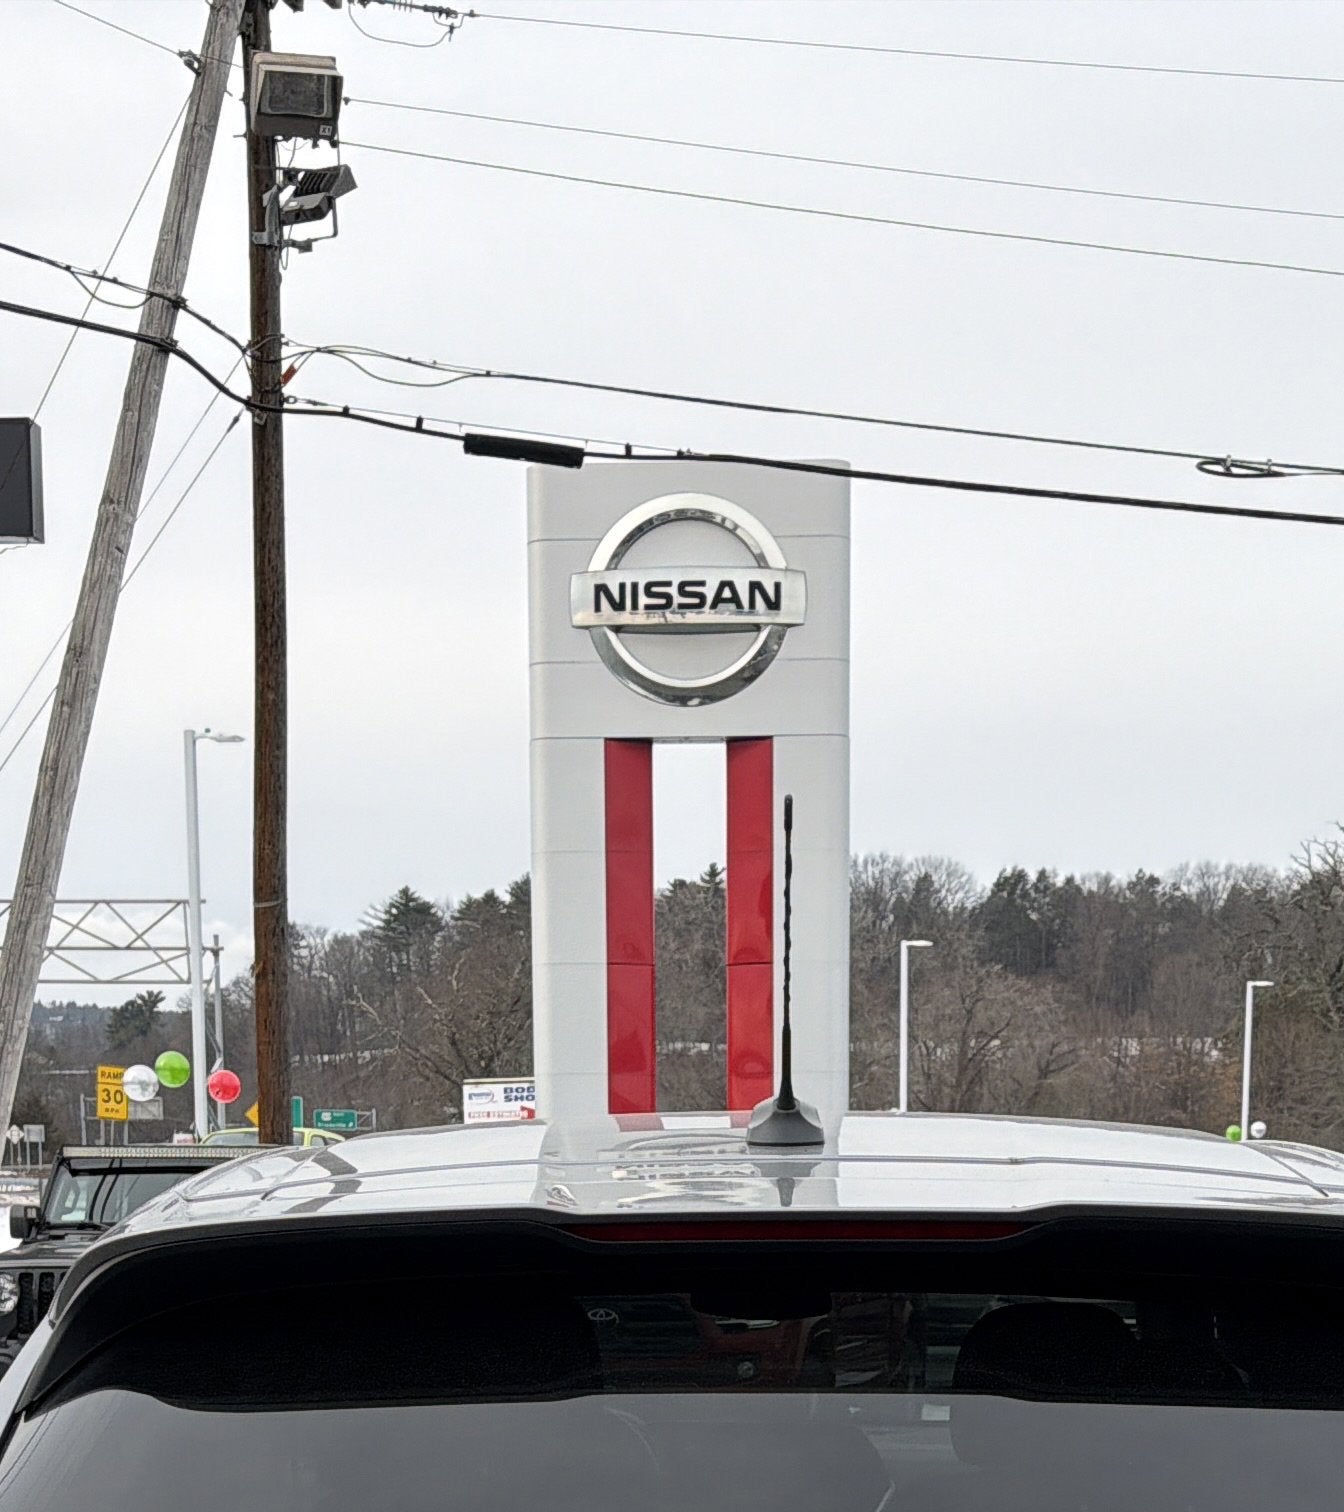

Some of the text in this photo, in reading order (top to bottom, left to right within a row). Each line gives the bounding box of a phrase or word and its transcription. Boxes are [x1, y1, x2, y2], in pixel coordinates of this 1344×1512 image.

[594, 580, 782, 613] NISSAN
[102, 1088, 124, 1105] 30
[504, 1094, 535, 1102] SHO
